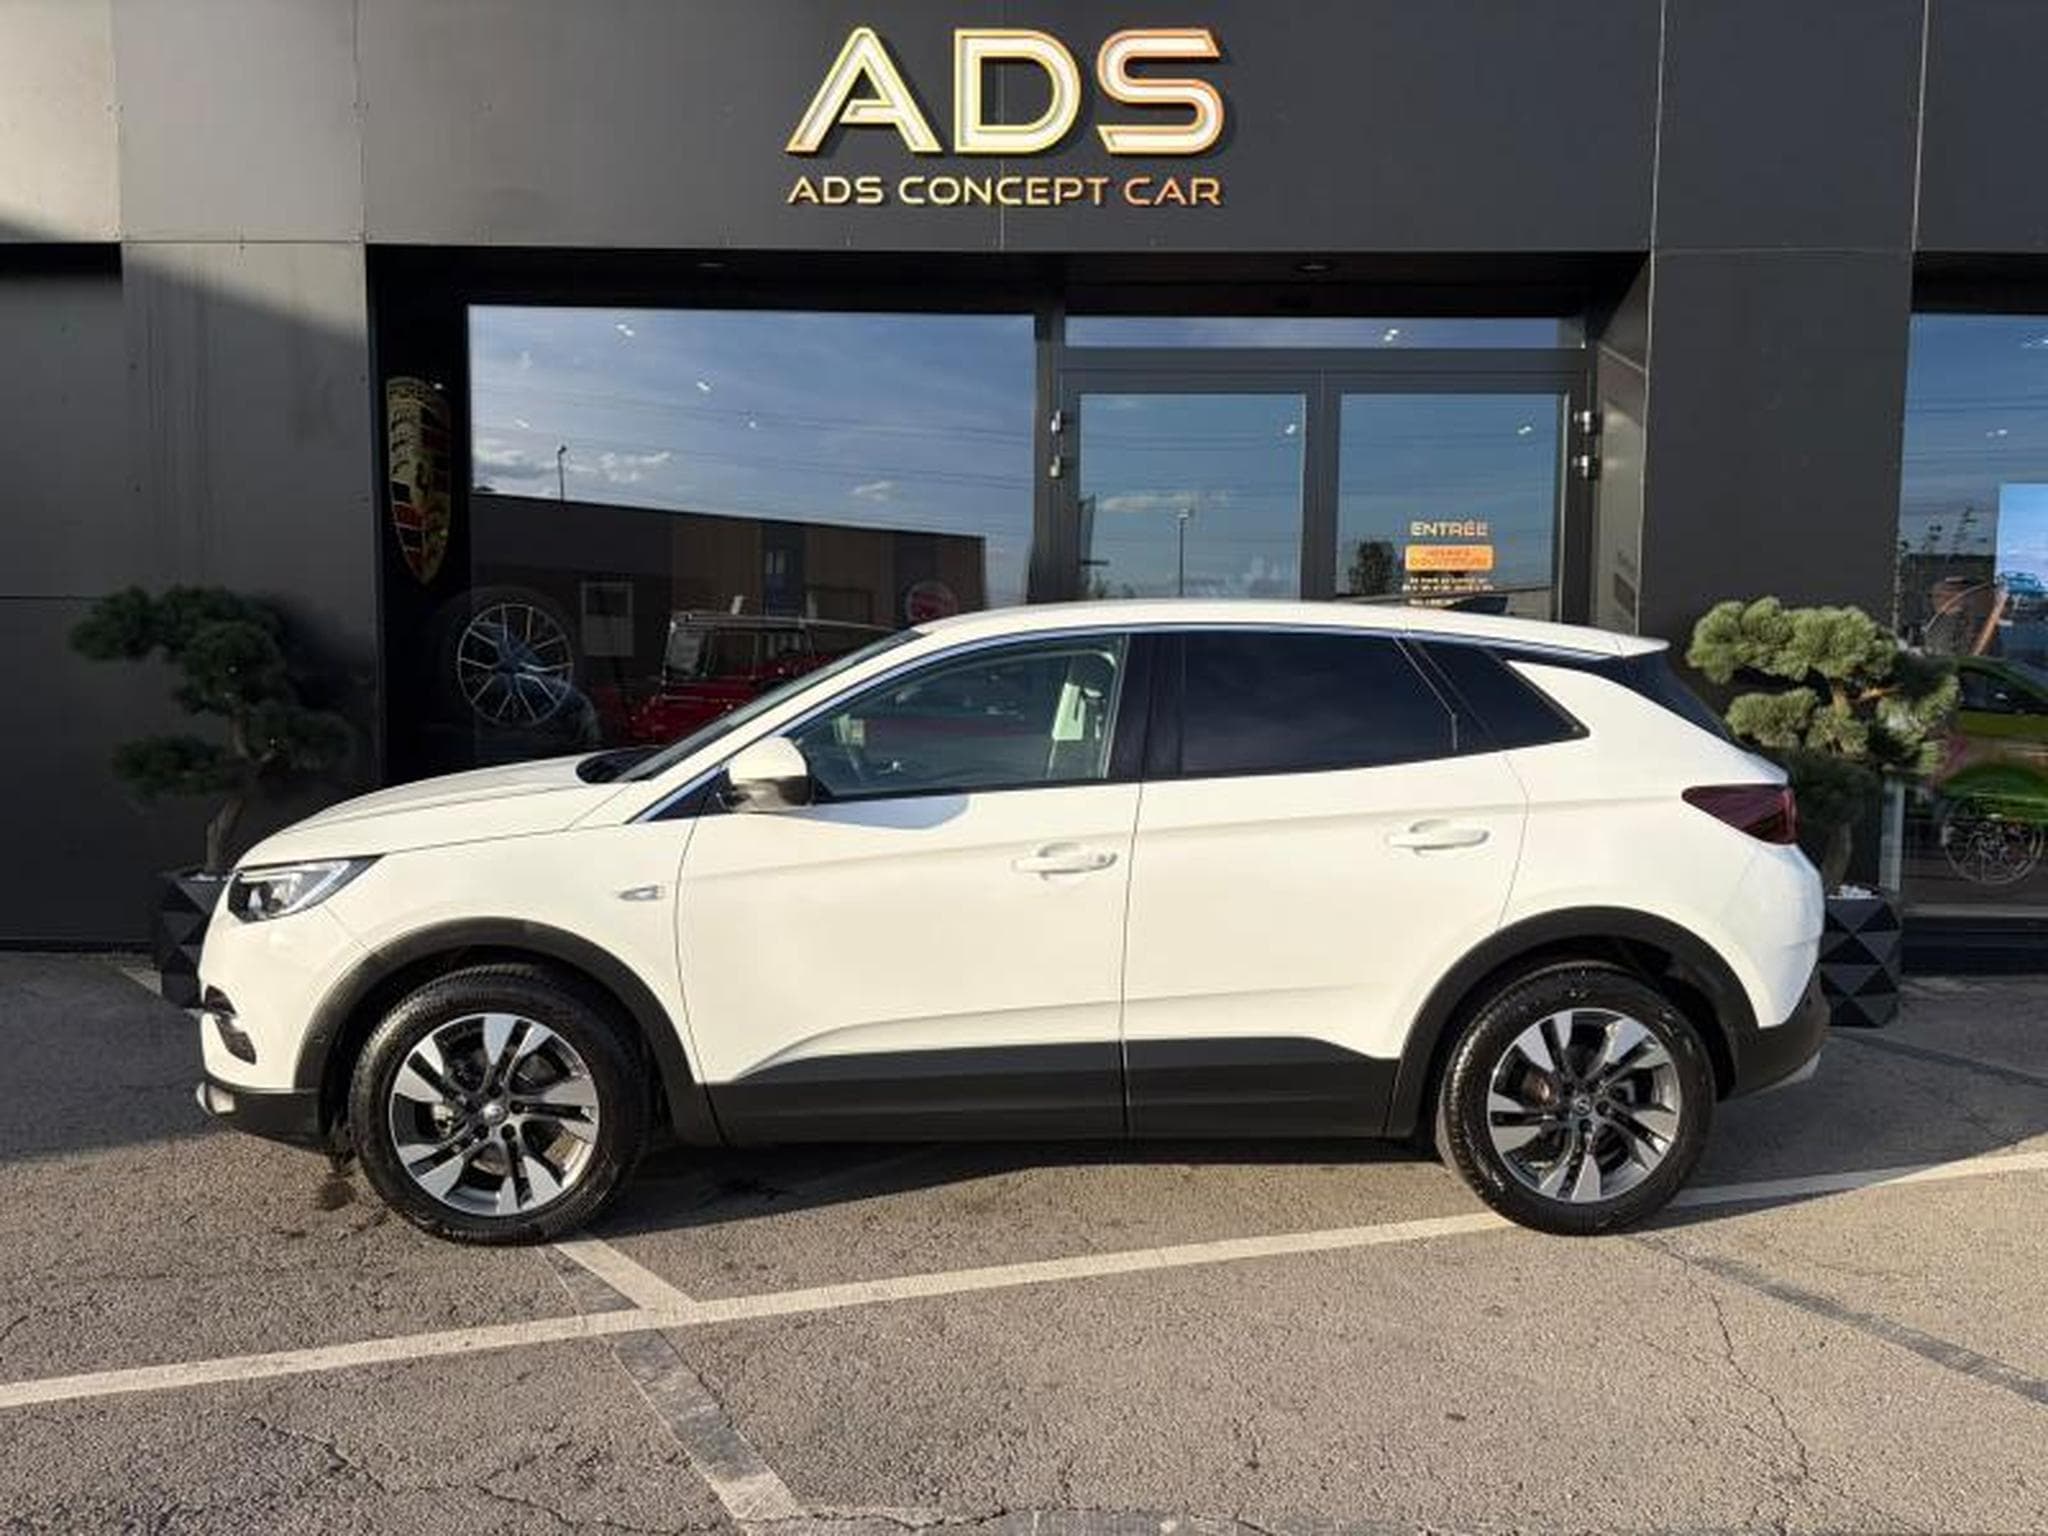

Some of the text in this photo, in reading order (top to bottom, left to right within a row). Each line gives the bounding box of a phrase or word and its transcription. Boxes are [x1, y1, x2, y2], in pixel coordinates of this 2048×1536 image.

[785, 26, 1225, 155] ADS
[787, 175, 1222, 207] ADS CONCEPT CAR
